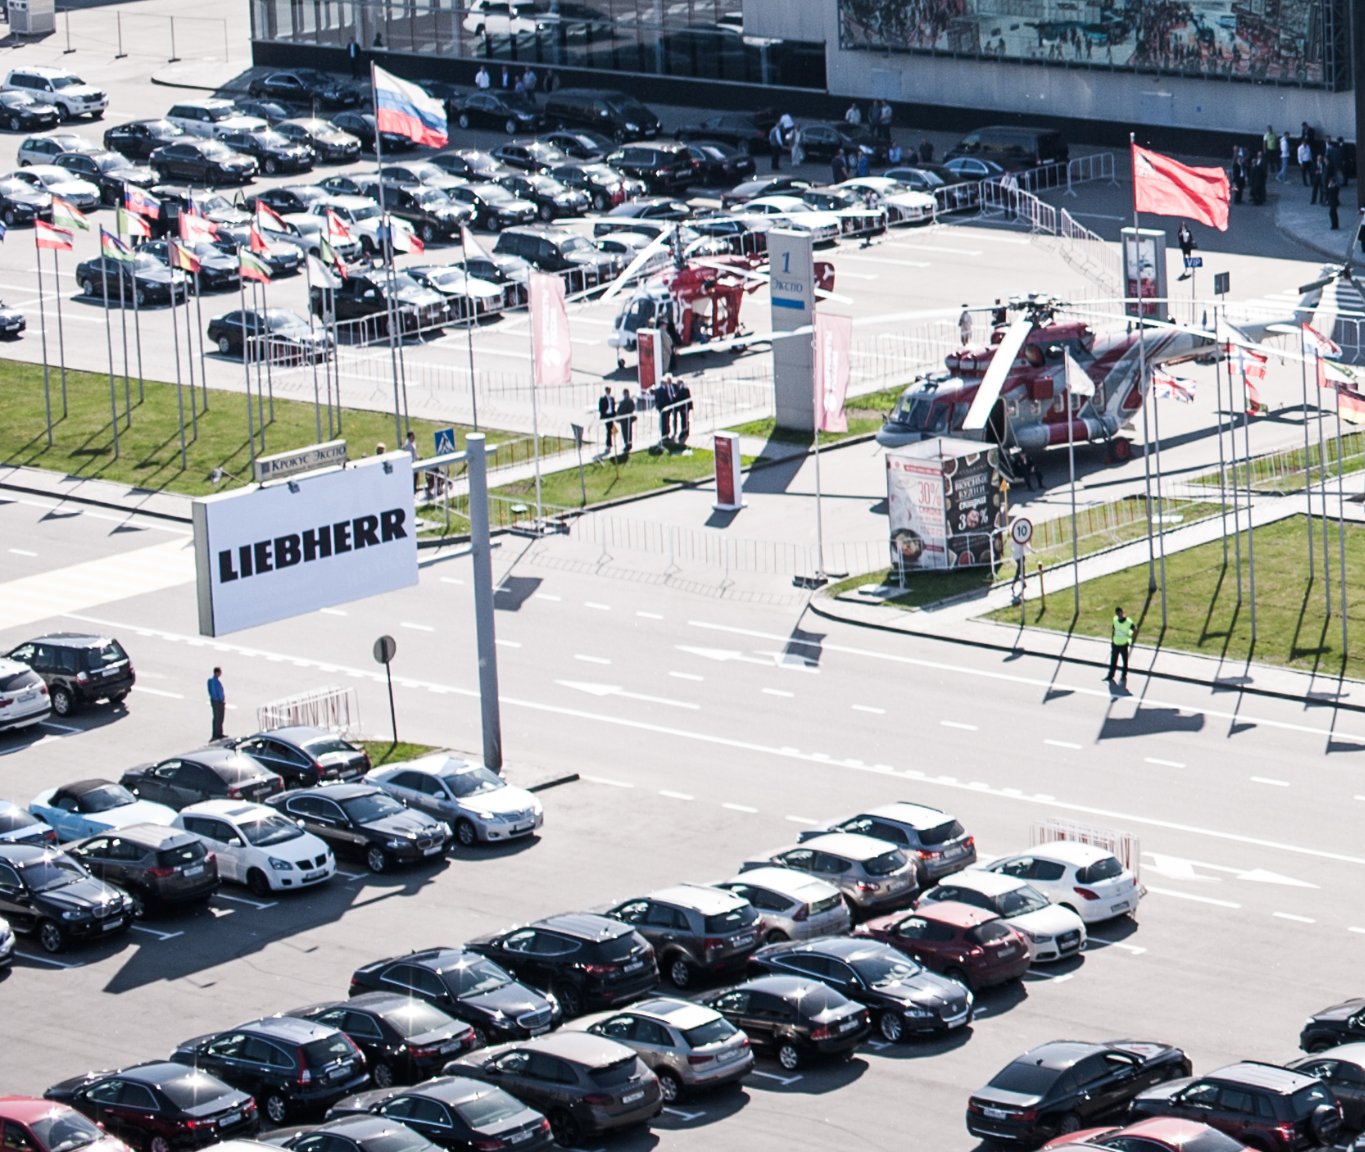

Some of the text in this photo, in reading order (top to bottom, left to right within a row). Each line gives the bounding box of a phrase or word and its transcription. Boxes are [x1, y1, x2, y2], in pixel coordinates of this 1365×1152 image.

[782, 251, 791, 274] 1
[1186, 257, 1201, 266] VIP
[1017, 527, 1028, 537] 10
[218, 508, 408, 584] LIEBHERR
